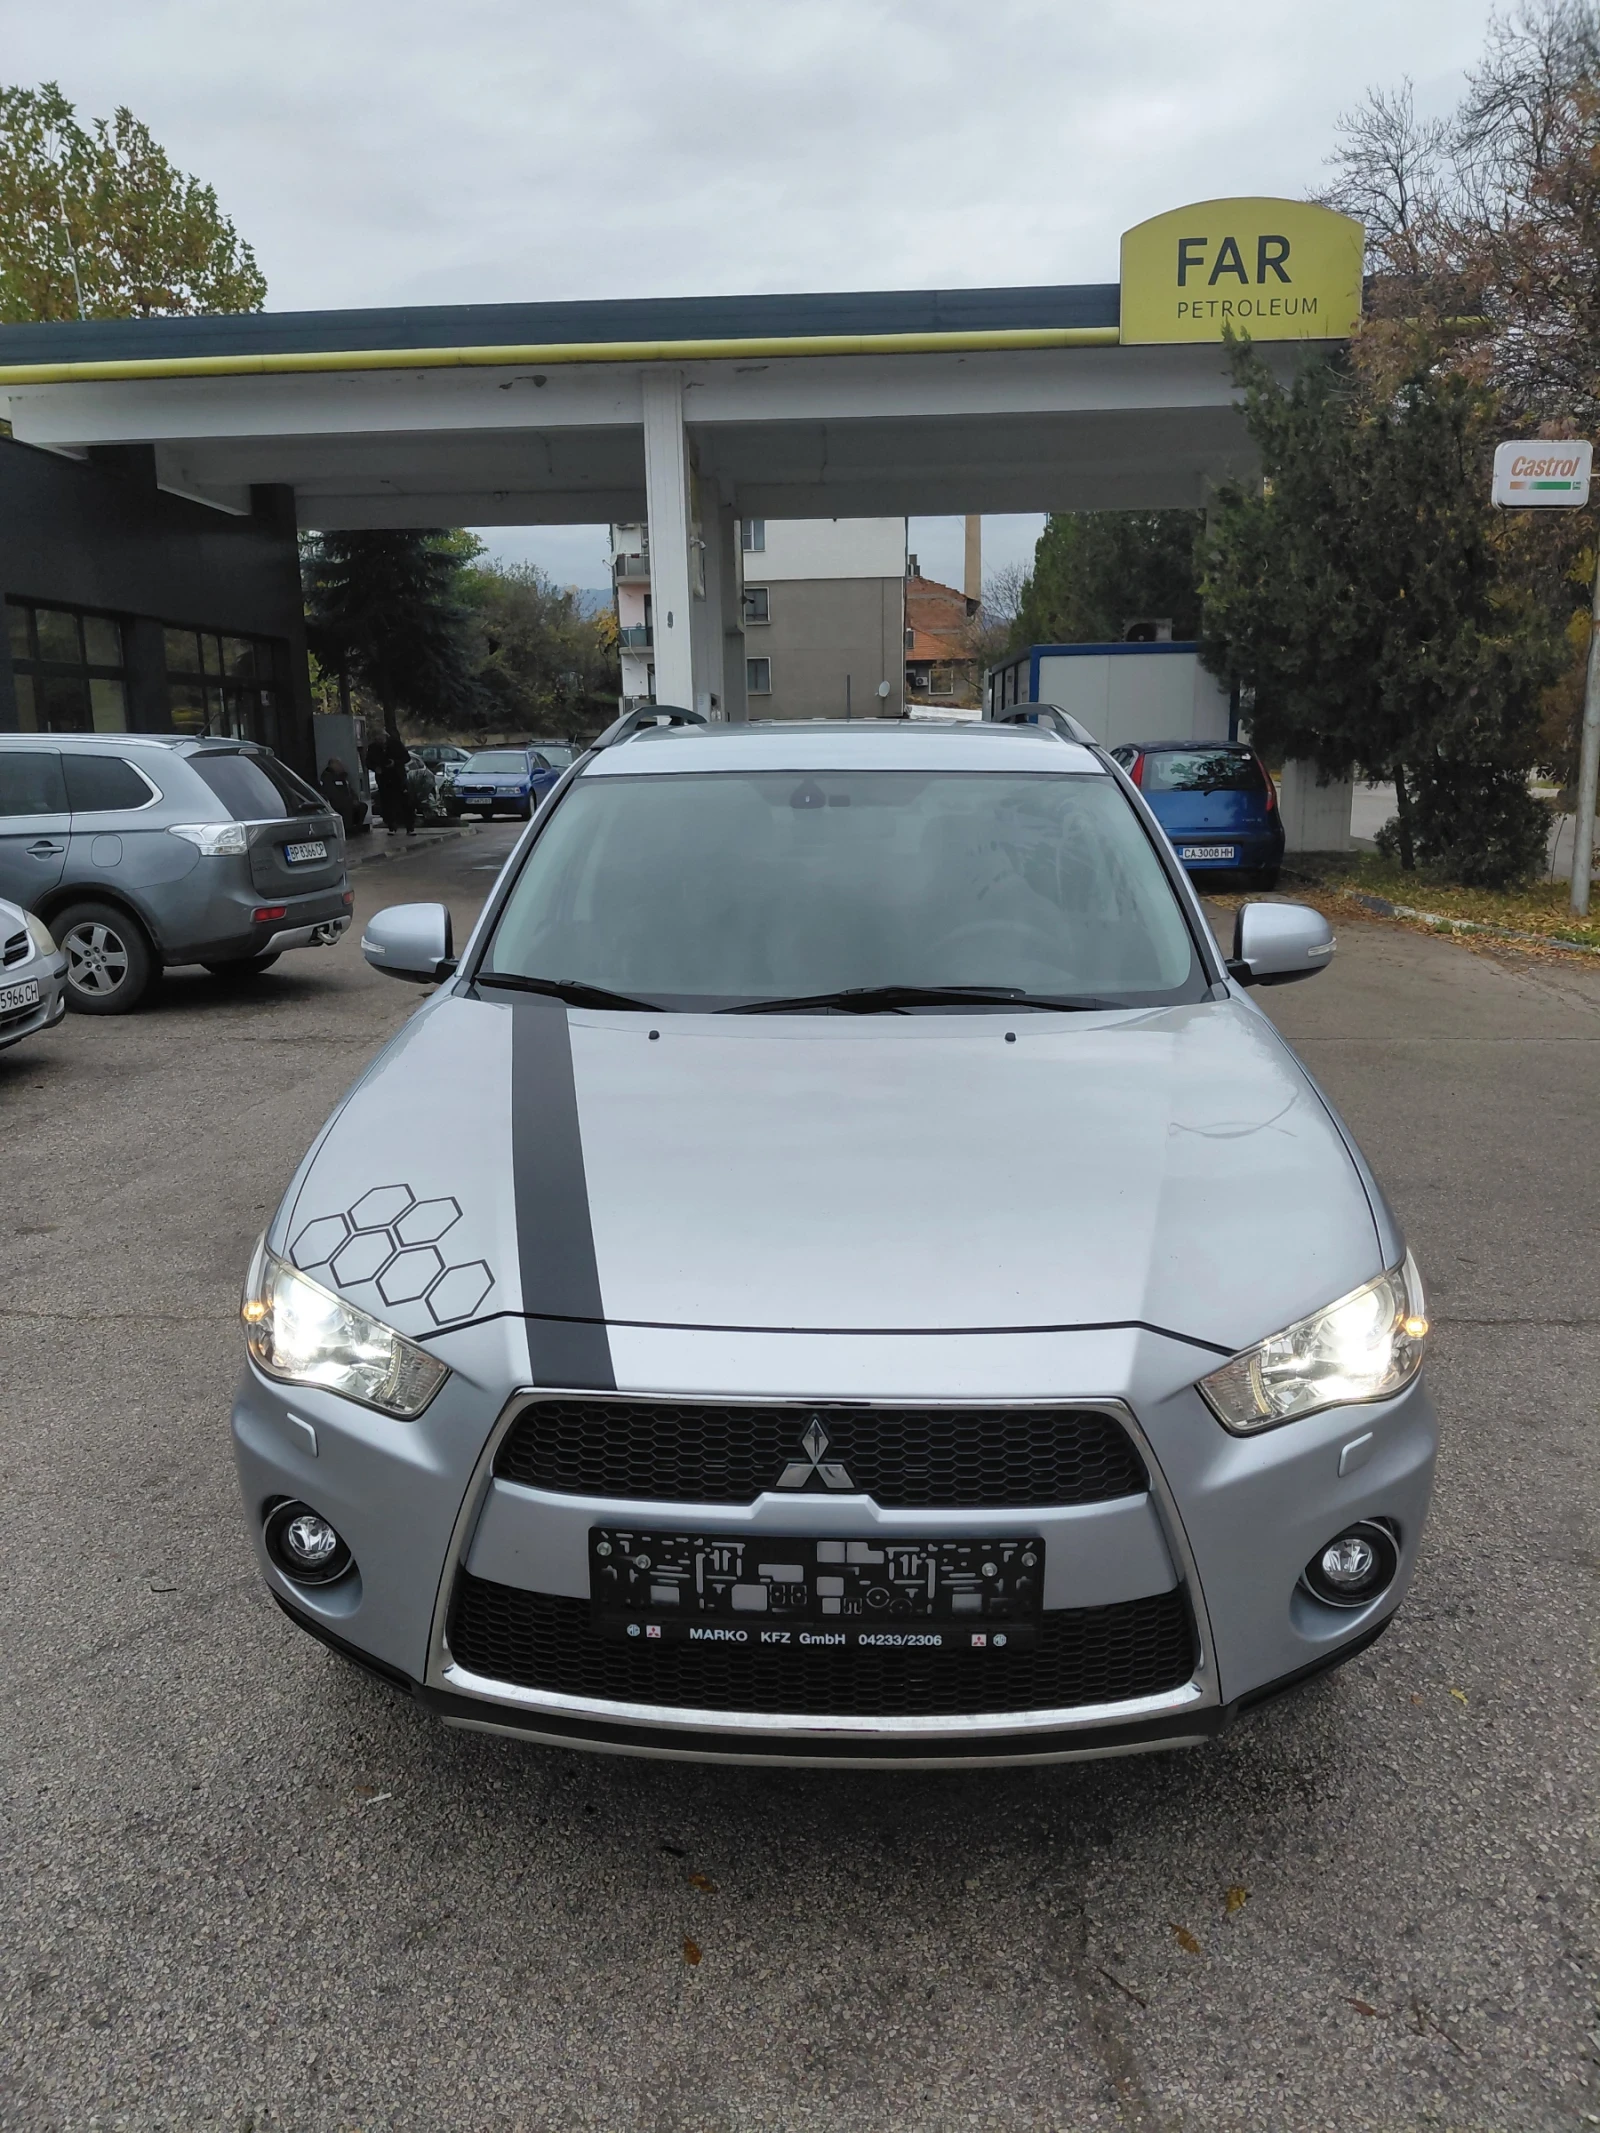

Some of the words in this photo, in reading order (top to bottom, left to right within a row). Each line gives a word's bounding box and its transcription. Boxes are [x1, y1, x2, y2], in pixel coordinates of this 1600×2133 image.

[1177, 235, 1292, 286] FAR
[1177, 298, 1317, 319] PETROLEUM
[1511, 456, 1580, 477] Castrol
[689, 1627, 748, 1642] MARKO
[760, 1631, 791, 1644] KFZ
[799, 1632, 846, 1645] GmbH
[858, 1634, 942, 1646] 04233/2306
